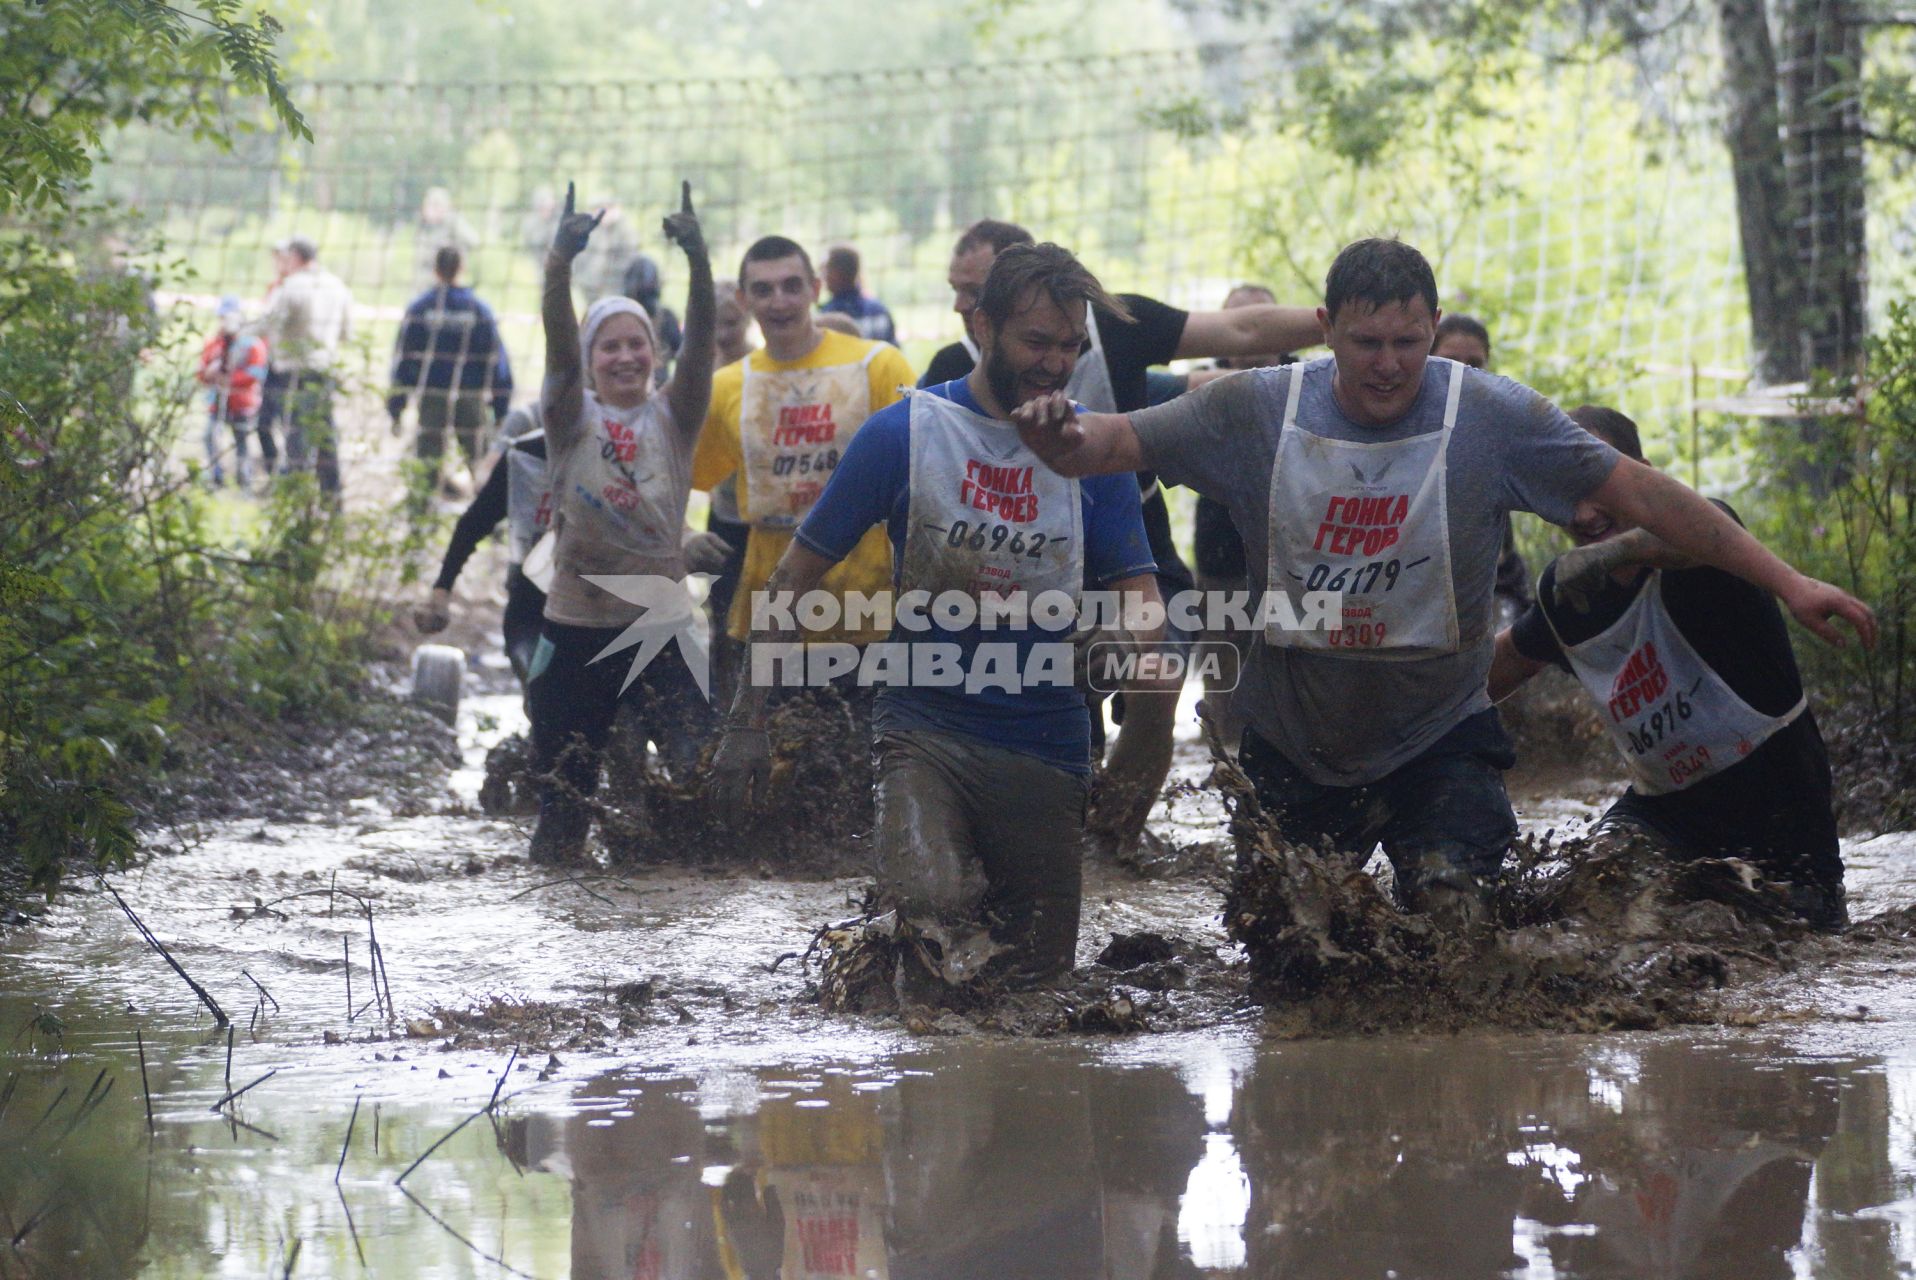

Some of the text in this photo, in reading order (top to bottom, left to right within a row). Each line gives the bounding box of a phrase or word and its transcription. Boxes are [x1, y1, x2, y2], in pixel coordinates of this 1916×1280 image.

[773, 449, 838, 476] 07548
[966, 459, 1034, 494] ГОНКА
[960, 479, 1039, 523] ГЕРОЕВ
[1325, 494, 1409, 526] ГОНКА
[948, 520, 1046, 558] 06962
[1306, 559, 1401, 594] 06179
[1328, 622, 1387, 648] 0309
[1628, 692, 1692, 755] 06976
